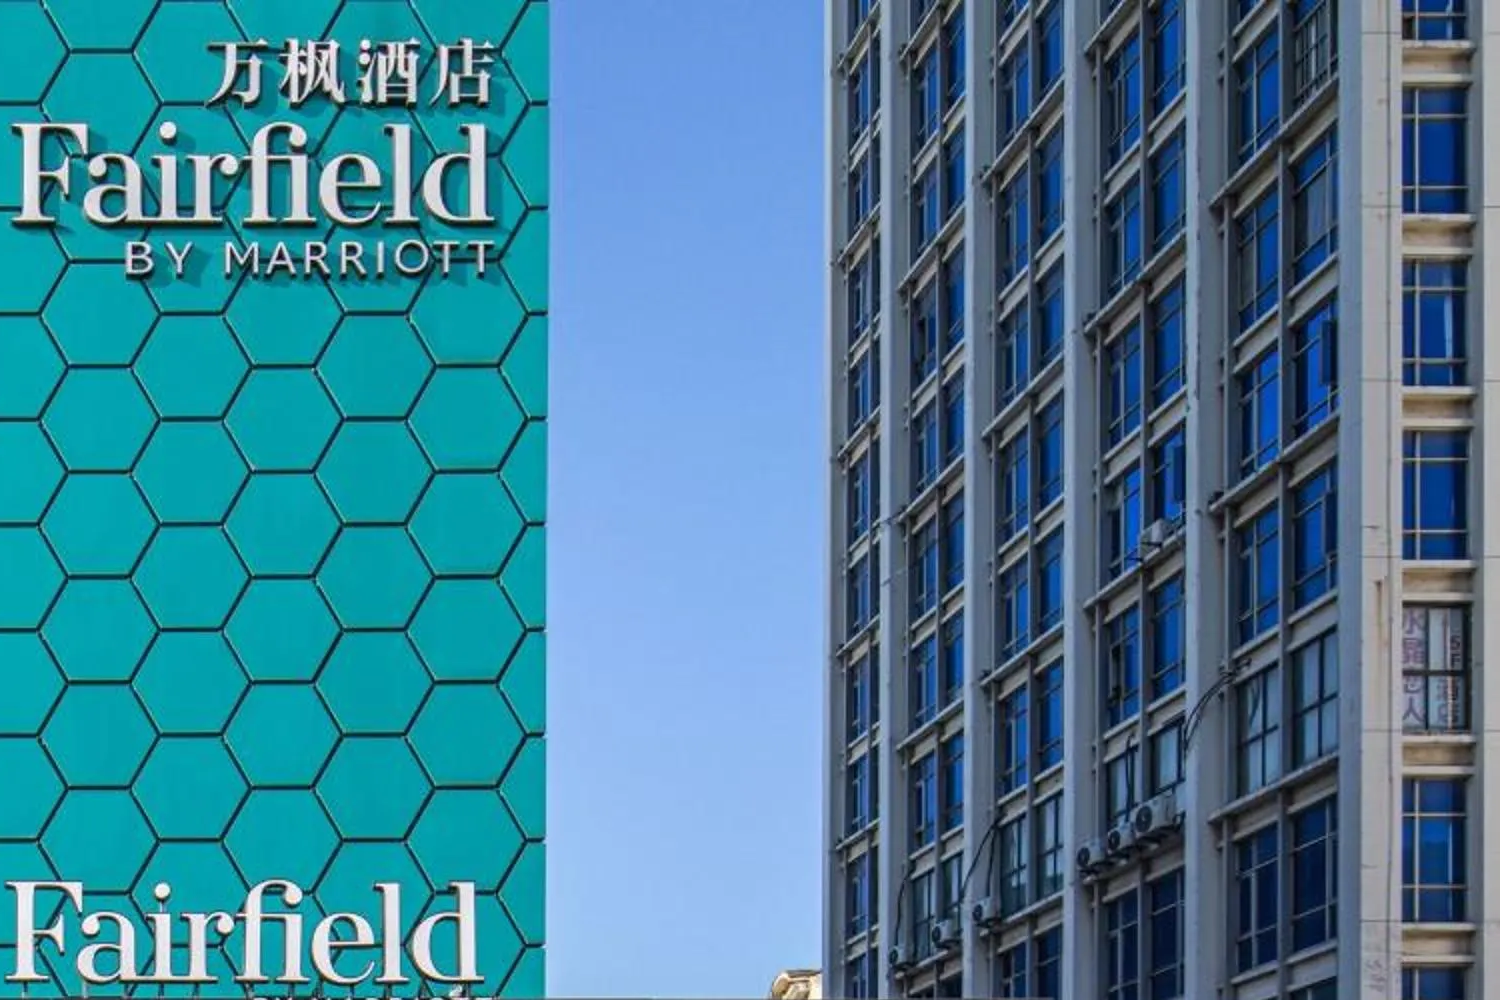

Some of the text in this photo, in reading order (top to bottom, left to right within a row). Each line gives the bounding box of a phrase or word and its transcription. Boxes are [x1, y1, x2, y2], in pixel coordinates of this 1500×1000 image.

[207, 37, 495, 107] 万枫酒店
[11, 121, 496, 227] Fairfield
[125, 239, 496, 279] BY MARRIOTT
[4, 879, 486, 984] Fairfield
